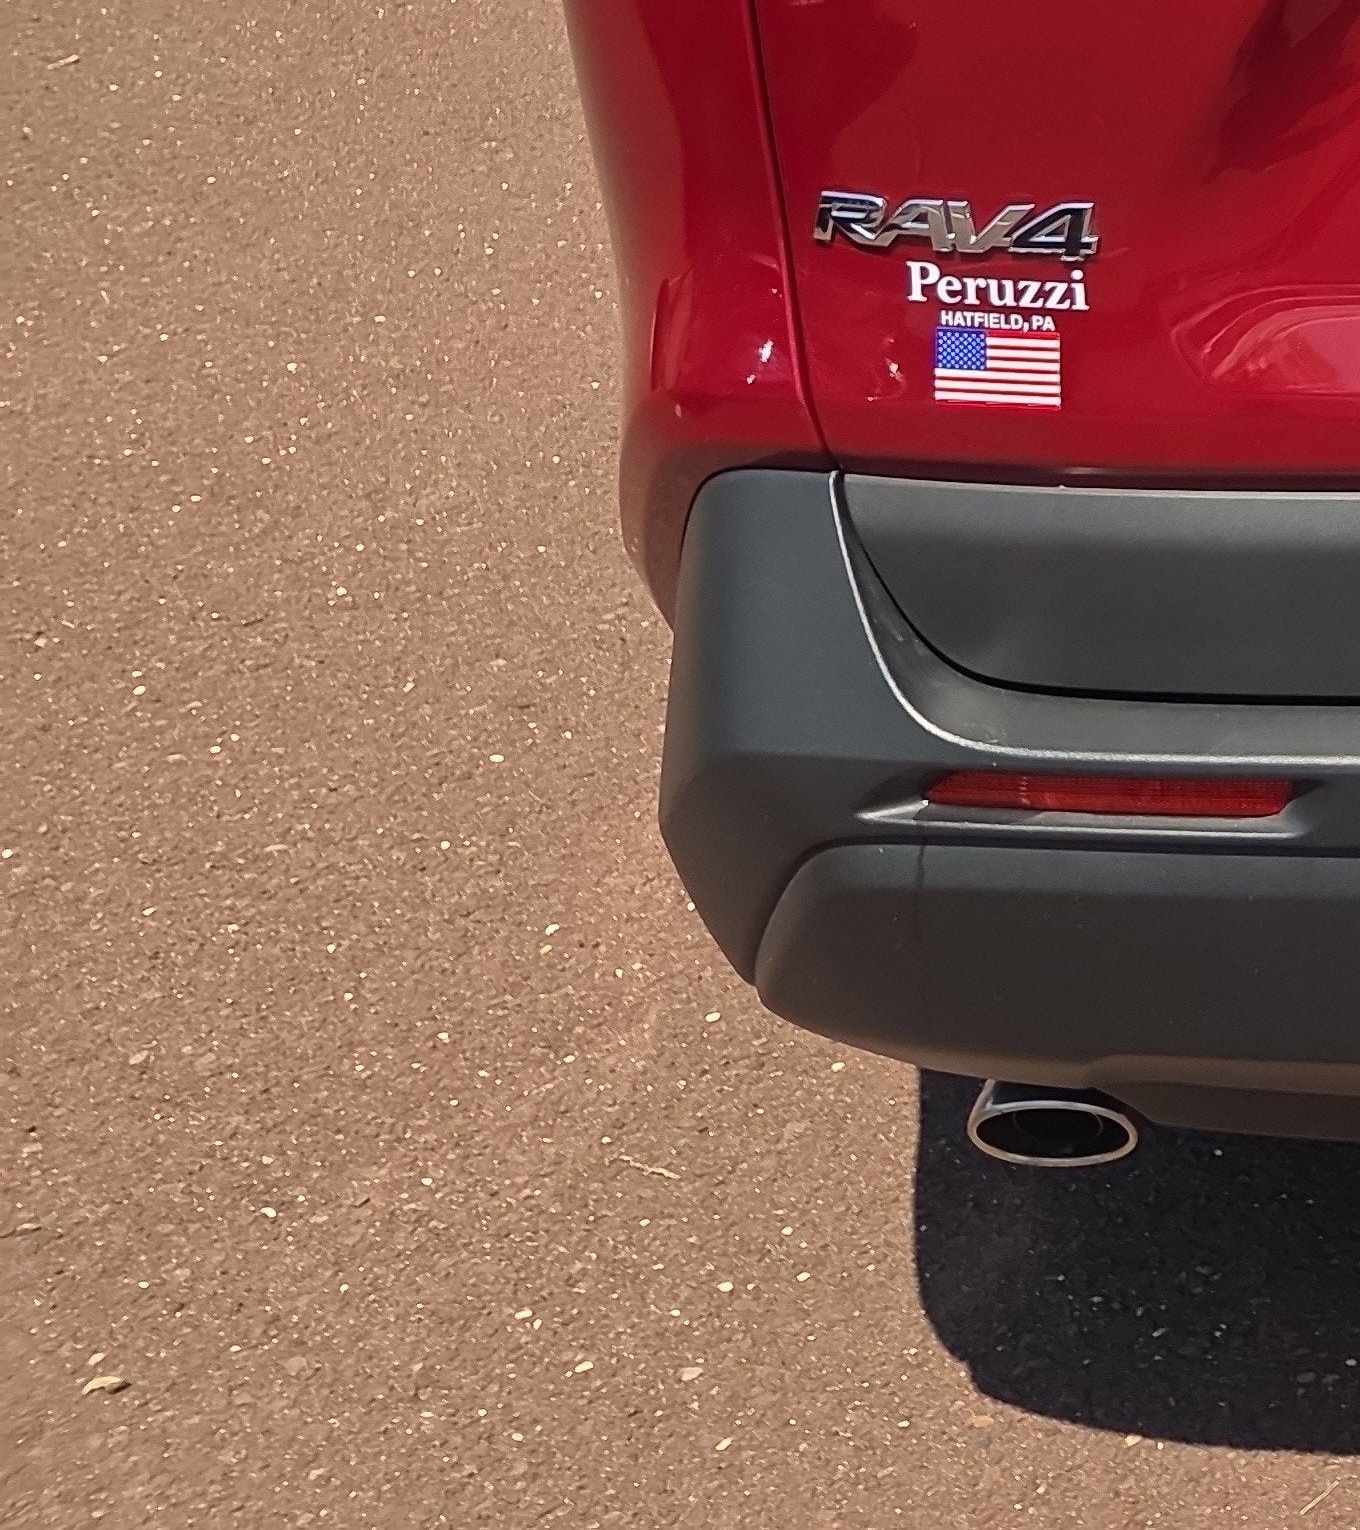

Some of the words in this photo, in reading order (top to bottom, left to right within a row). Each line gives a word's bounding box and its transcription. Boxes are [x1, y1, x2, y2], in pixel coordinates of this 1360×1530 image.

[813, 190, 1099, 262] RAV4
[905, 261, 1090, 310] Peruzzi
[940, 310, 1031, 332] HATFIELD,
[1032, 315, 1056, 331] PA
